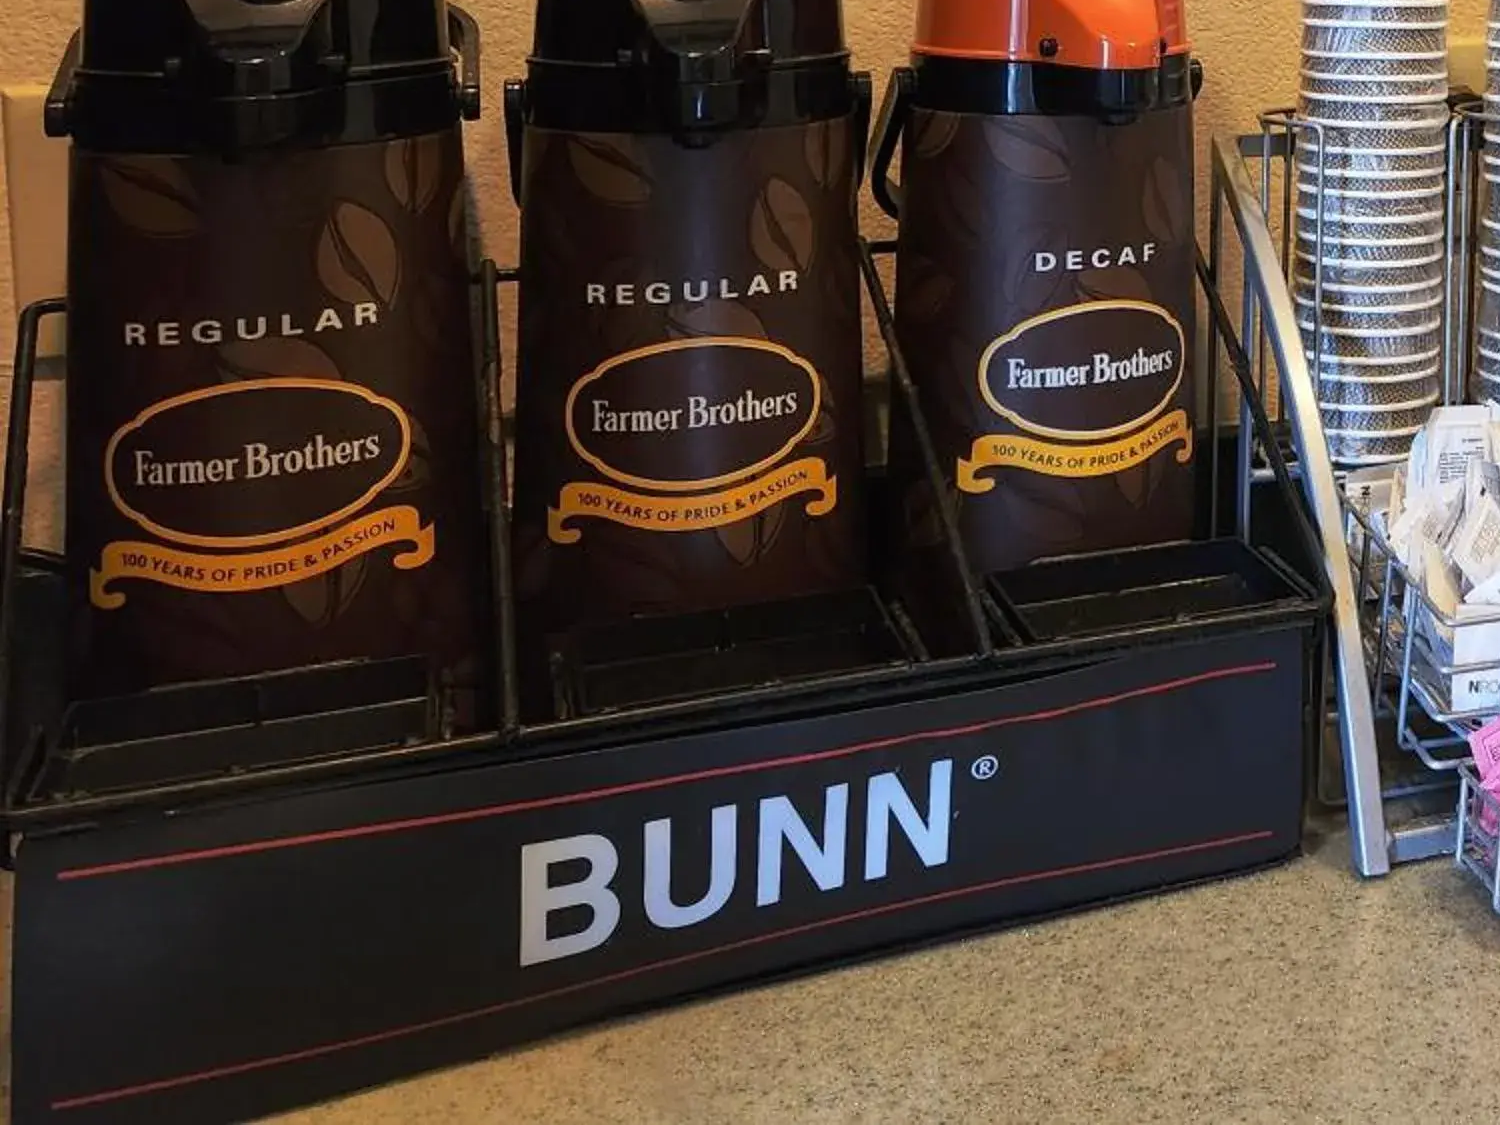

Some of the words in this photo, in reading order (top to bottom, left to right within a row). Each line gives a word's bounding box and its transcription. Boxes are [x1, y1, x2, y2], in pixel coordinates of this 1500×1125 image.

[1035, 243, 1157, 272] DECAF
[587, 270, 799, 304] REGULAR
[124, 301, 379, 346] REGULAR
[1007, 357, 1091, 389] Farmer
[1092, 347, 1173, 384] Brothers
[591, 399, 683, 433] Farmer
[687, 389, 798, 430] Brothers
[134, 450, 241, 486] Farmer
[243, 433, 382, 480] Brothers
[1020, 449, 1064, 468] YEARS
[1066, 457, 1085, 468] OF
[1089, 450, 1127, 467] PRIDE
[1128, 446, 1138, 458] &
[1139, 421, 1180, 453] PASSION
[576, 491, 602, 507] 100
[604, 498, 654, 521] YEARS
[657, 510, 681, 522] OF
[684, 504, 731, 521] PRIDE
[734, 497, 747, 511] &
[749, 470, 810, 506] PASSION
[121, 552, 147, 568] 100
[150, 555, 205, 582] YEARS
[211, 568, 238, 583] OF
[243, 558, 299, 581] PRIDE
[303, 552, 319, 568] &
[320, 518, 397, 561] PASSION
